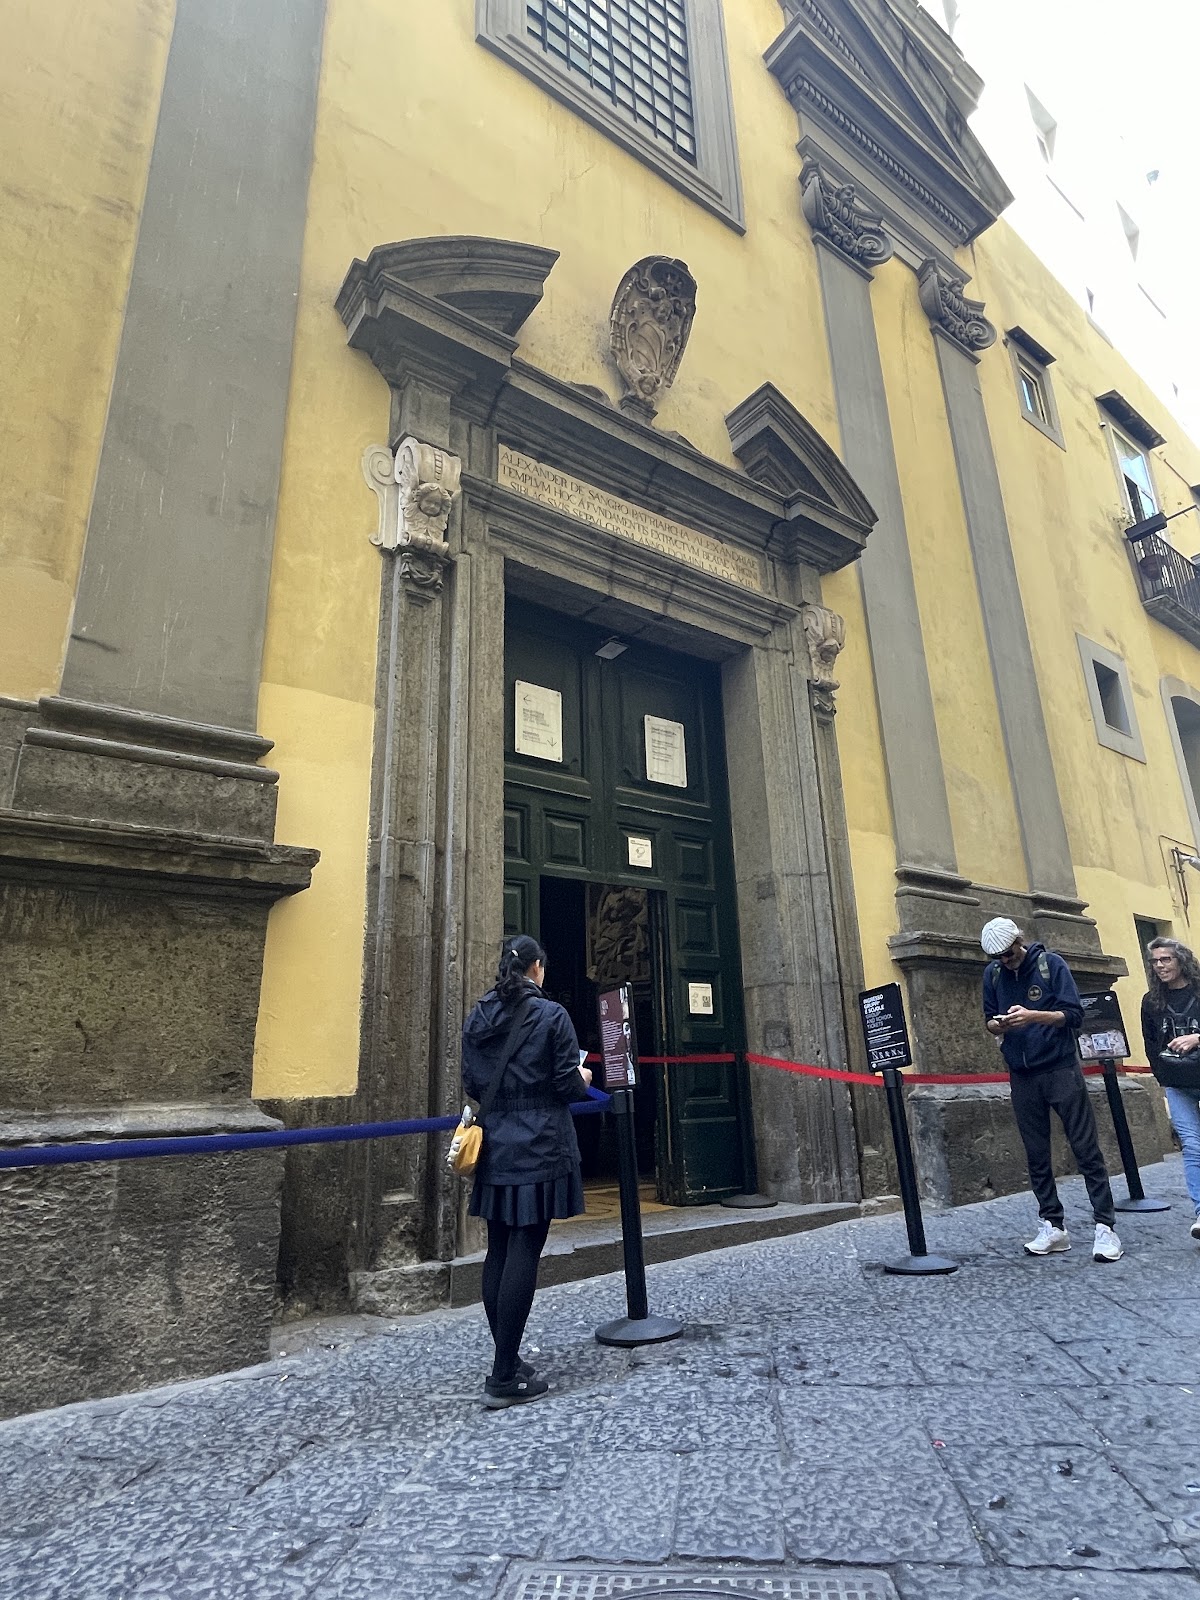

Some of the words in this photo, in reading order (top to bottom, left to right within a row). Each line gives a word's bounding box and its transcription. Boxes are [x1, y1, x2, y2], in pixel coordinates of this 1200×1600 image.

[501, 463, 551, 494] TEMPLVM
[554, 487, 576, 504] HOC
[501, 452, 567, 488] ALEXANDER
[571, 482, 585, 495] DE
[588, 489, 629, 515] SANGRO
[632, 508, 690, 541] PATRIARCHA
